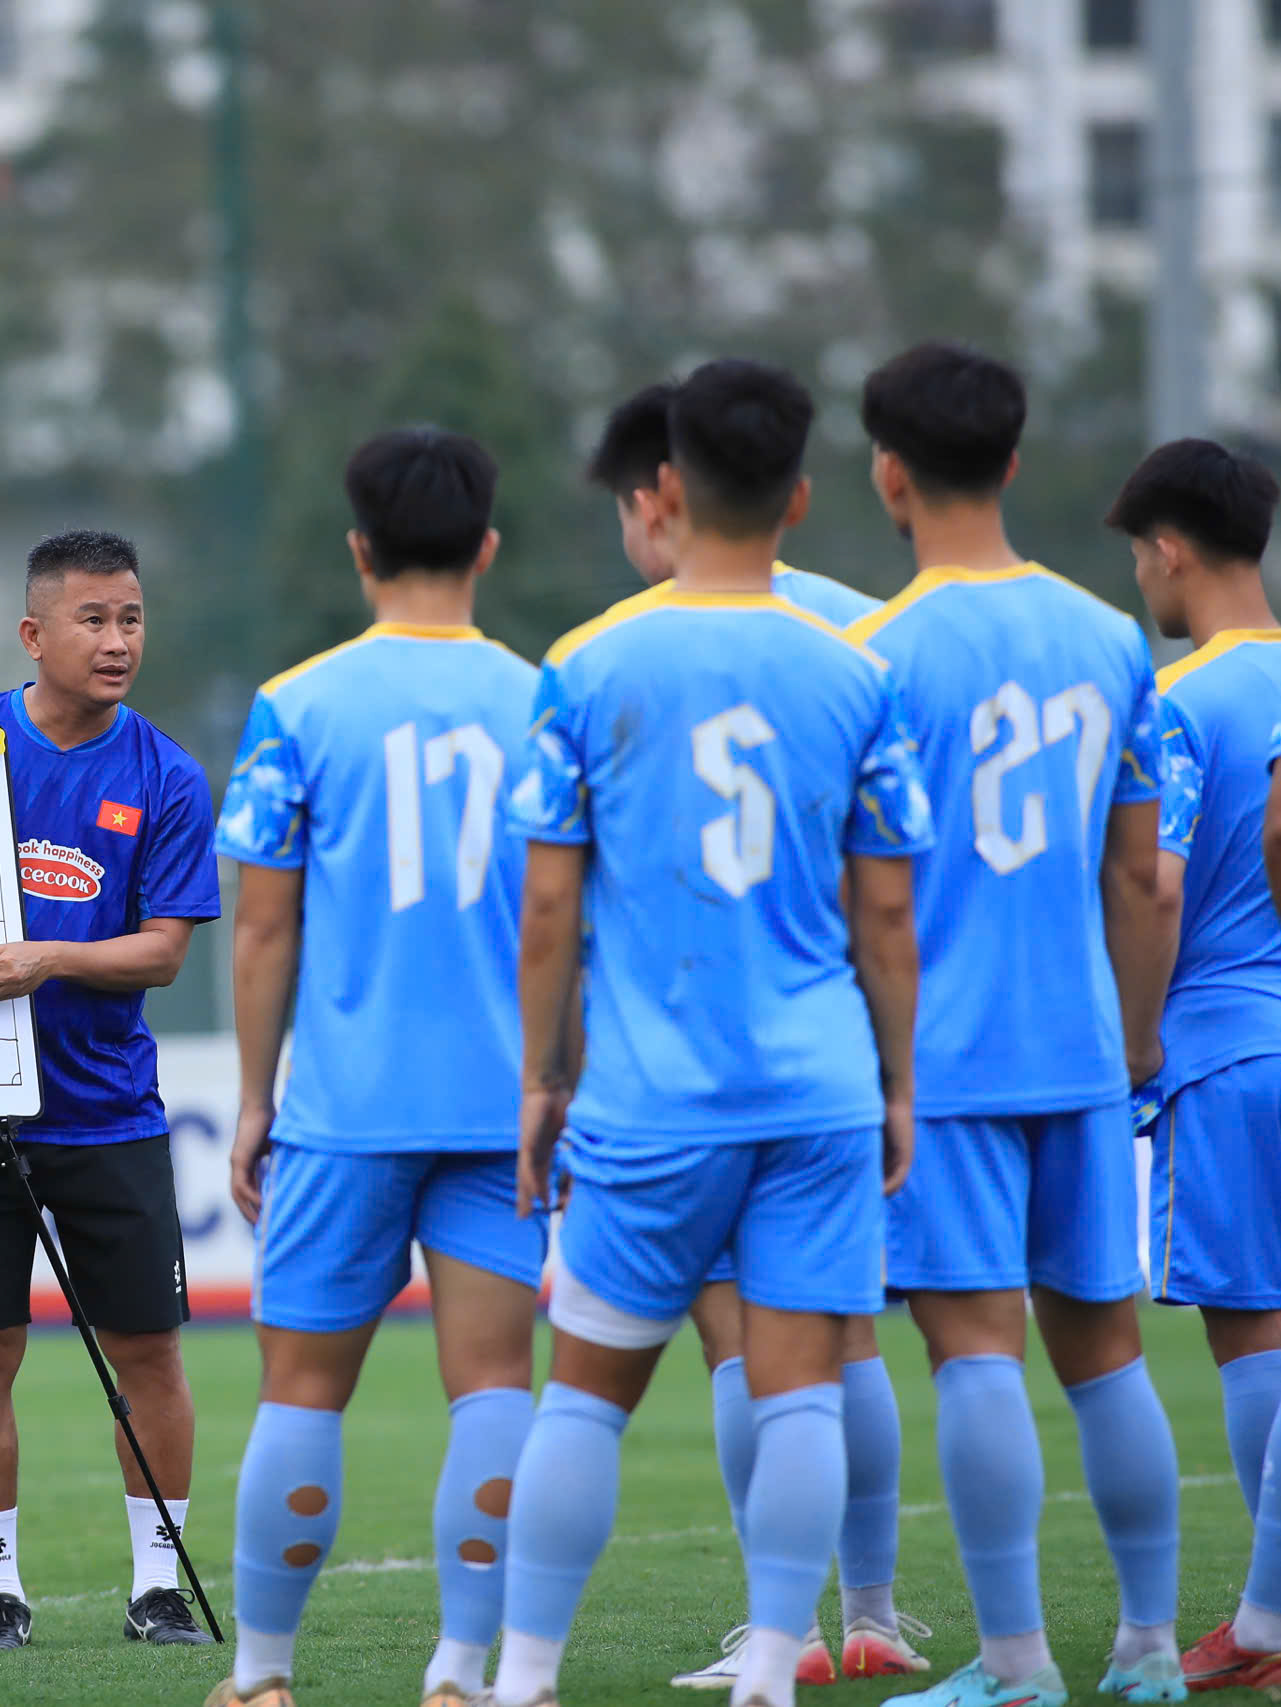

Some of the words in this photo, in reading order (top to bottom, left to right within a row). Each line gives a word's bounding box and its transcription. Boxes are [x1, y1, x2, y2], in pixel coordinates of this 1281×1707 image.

[18, 841, 39, 854] ok
[43, 843, 102, 877] happiness
[384, 721, 505, 912] 17
[691, 703, 776, 898] 5
[970, 680, 1111, 876] 27
[20, 866, 91, 894] cecook
